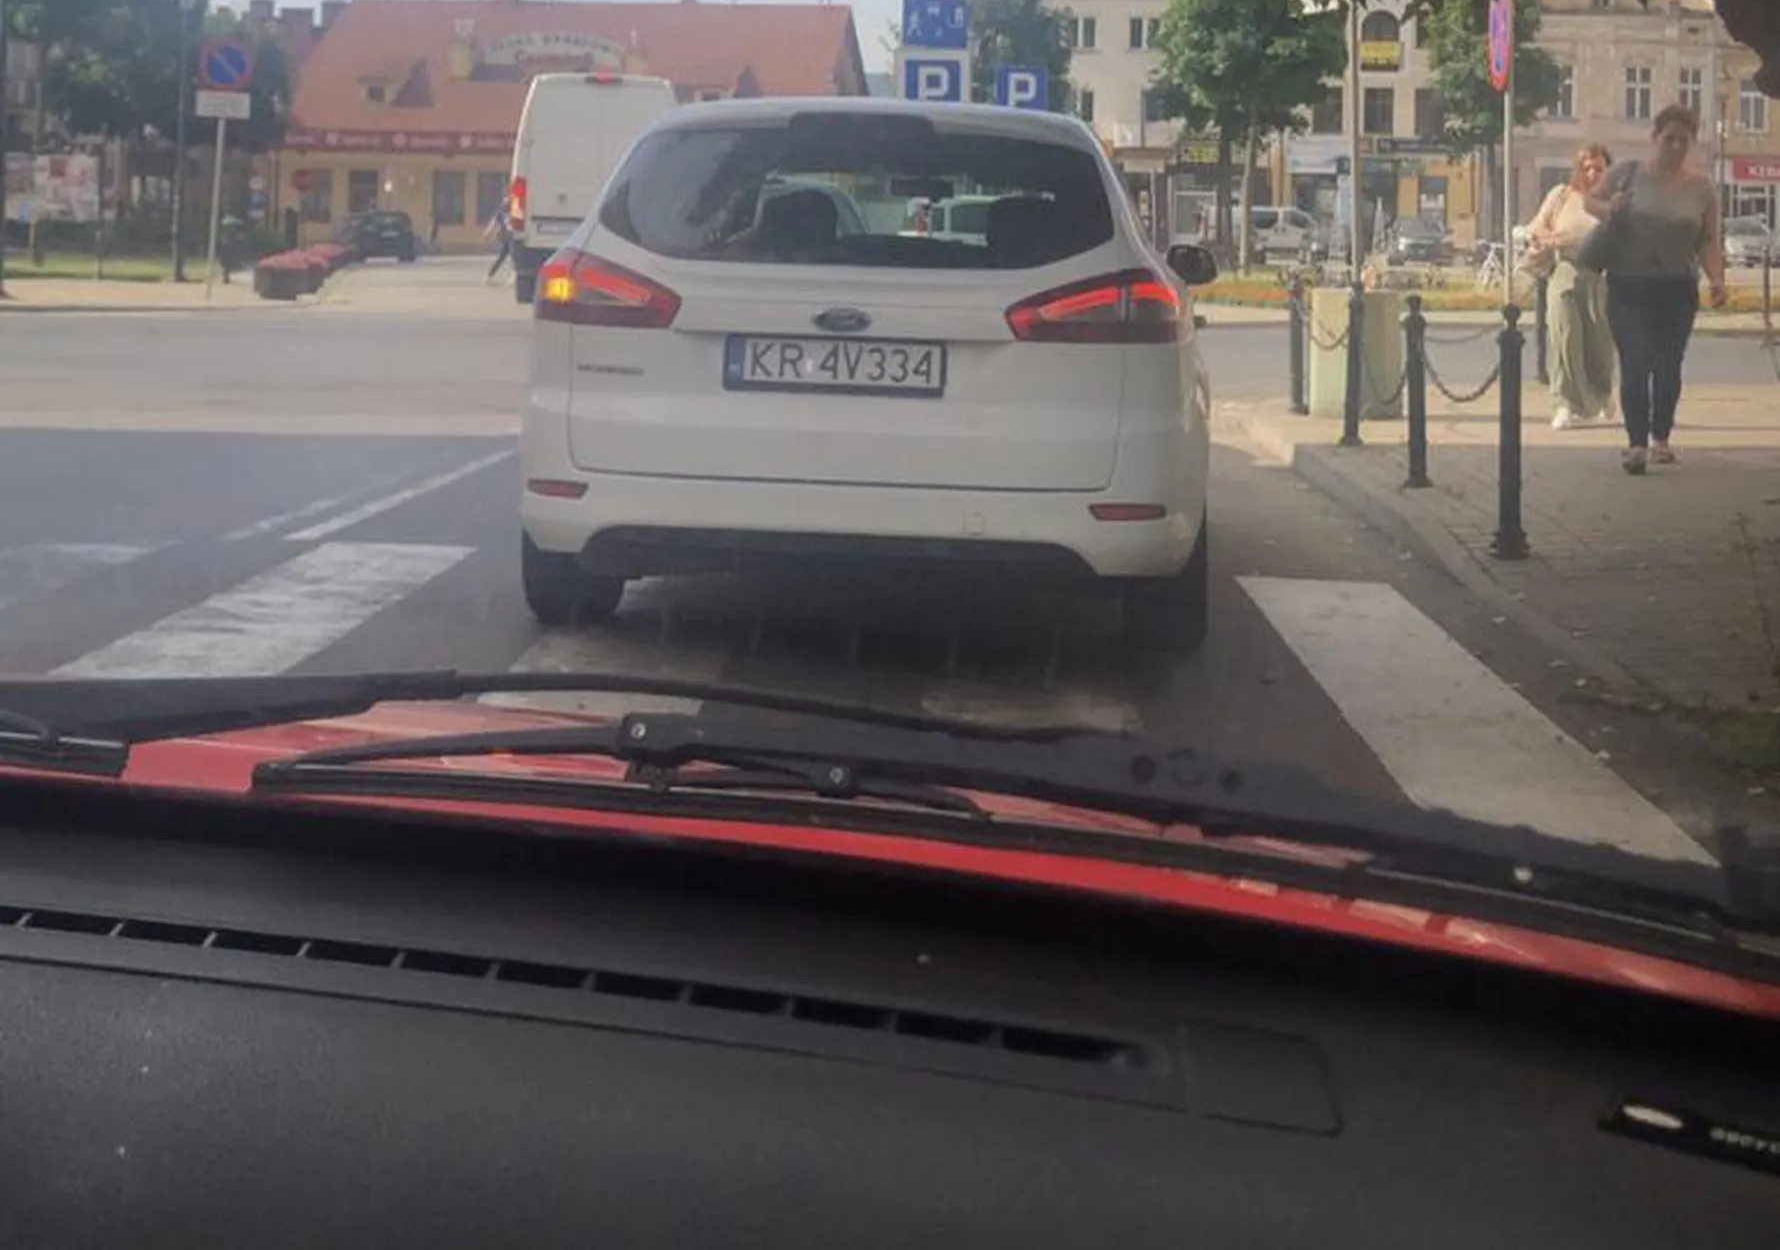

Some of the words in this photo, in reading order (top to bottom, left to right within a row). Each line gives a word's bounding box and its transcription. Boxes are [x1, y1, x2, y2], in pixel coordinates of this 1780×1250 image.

[918, 66, 949, 101] P
[1008, 72, 1036, 106] P
[750, 343, 804, 379] KR
[819, 343, 933, 385] 4V334
